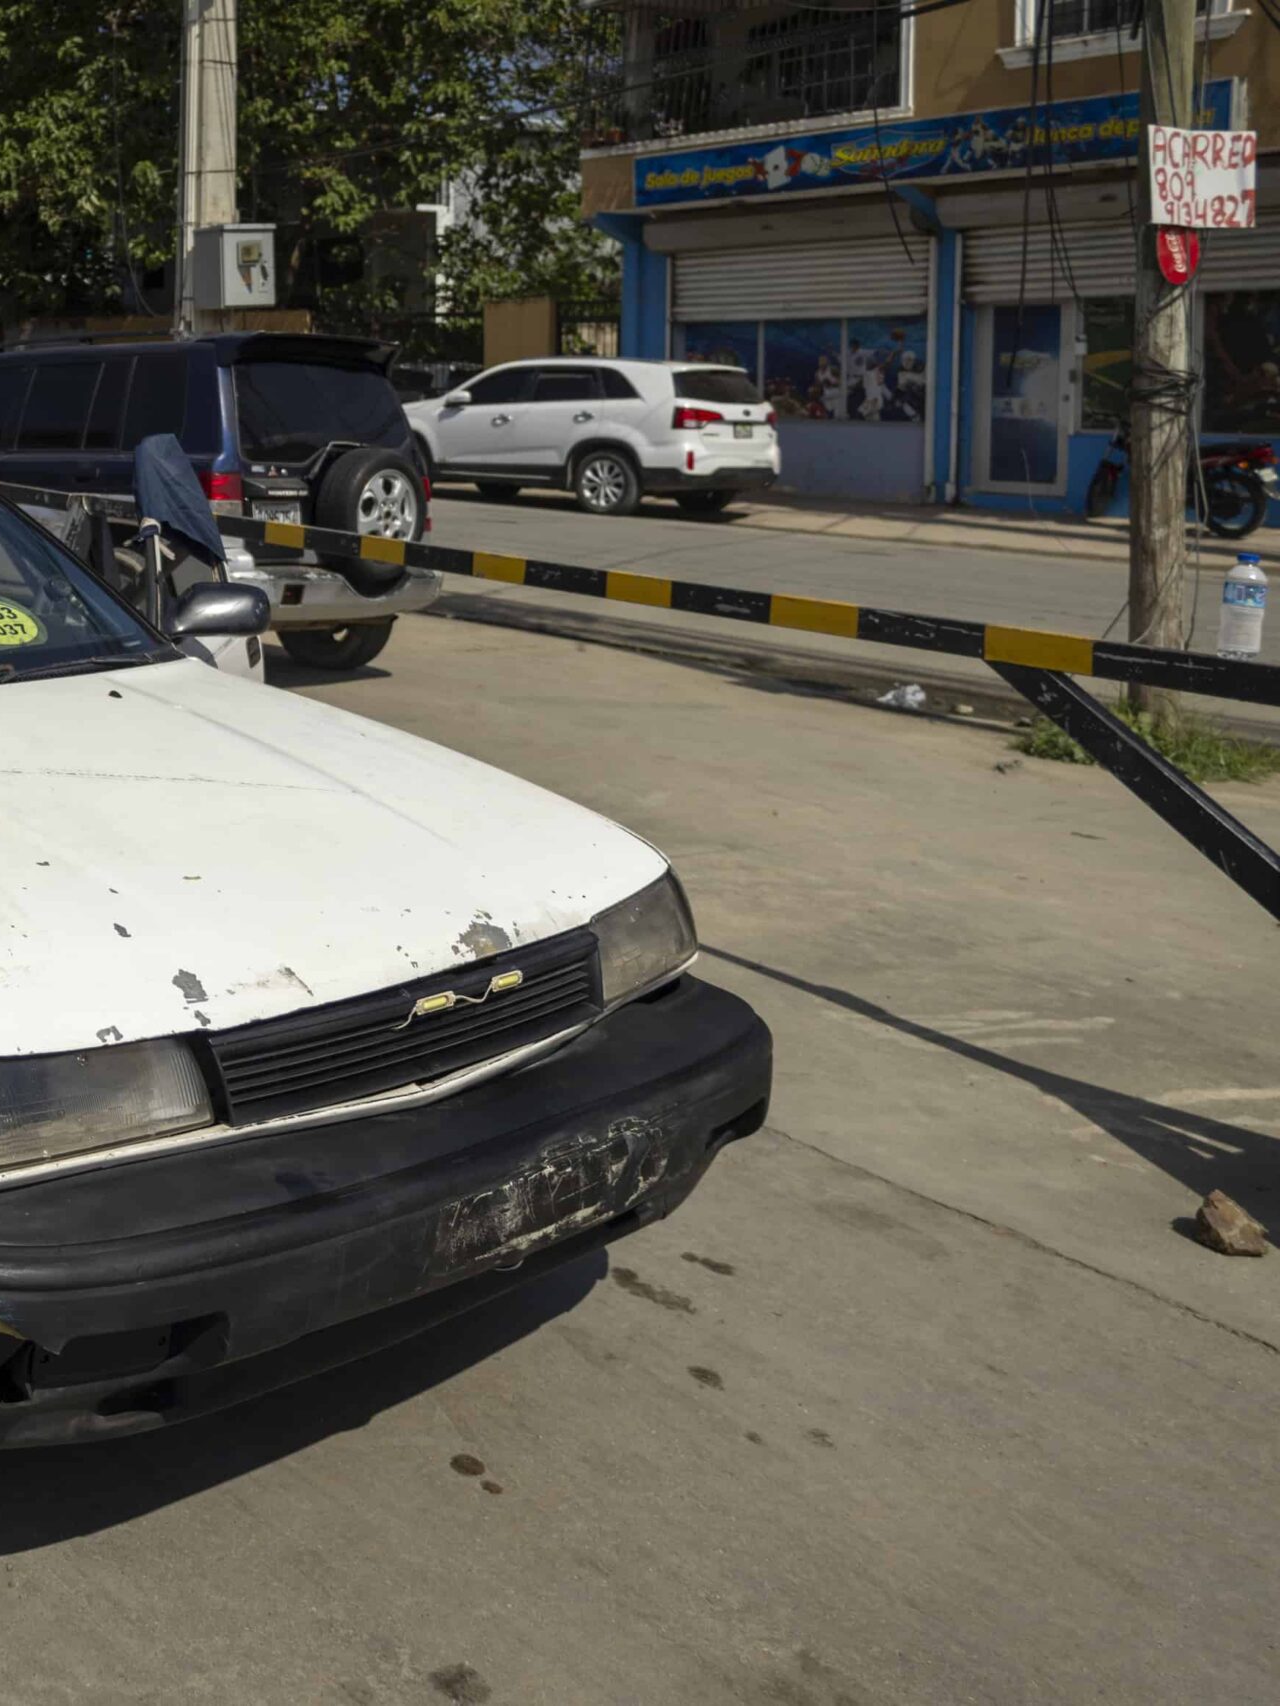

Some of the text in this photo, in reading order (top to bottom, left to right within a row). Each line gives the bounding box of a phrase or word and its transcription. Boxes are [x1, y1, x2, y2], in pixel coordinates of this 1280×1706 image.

[1098, 116, 1139, 141] dep
[1153, 127, 1257, 170] ACARREO
[645, 171, 677, 189] Sala
[679, 168, 700, 186] de
[1155, 167, 1196, 202] 809
[1165, 189, 1257, 228] 9134827
